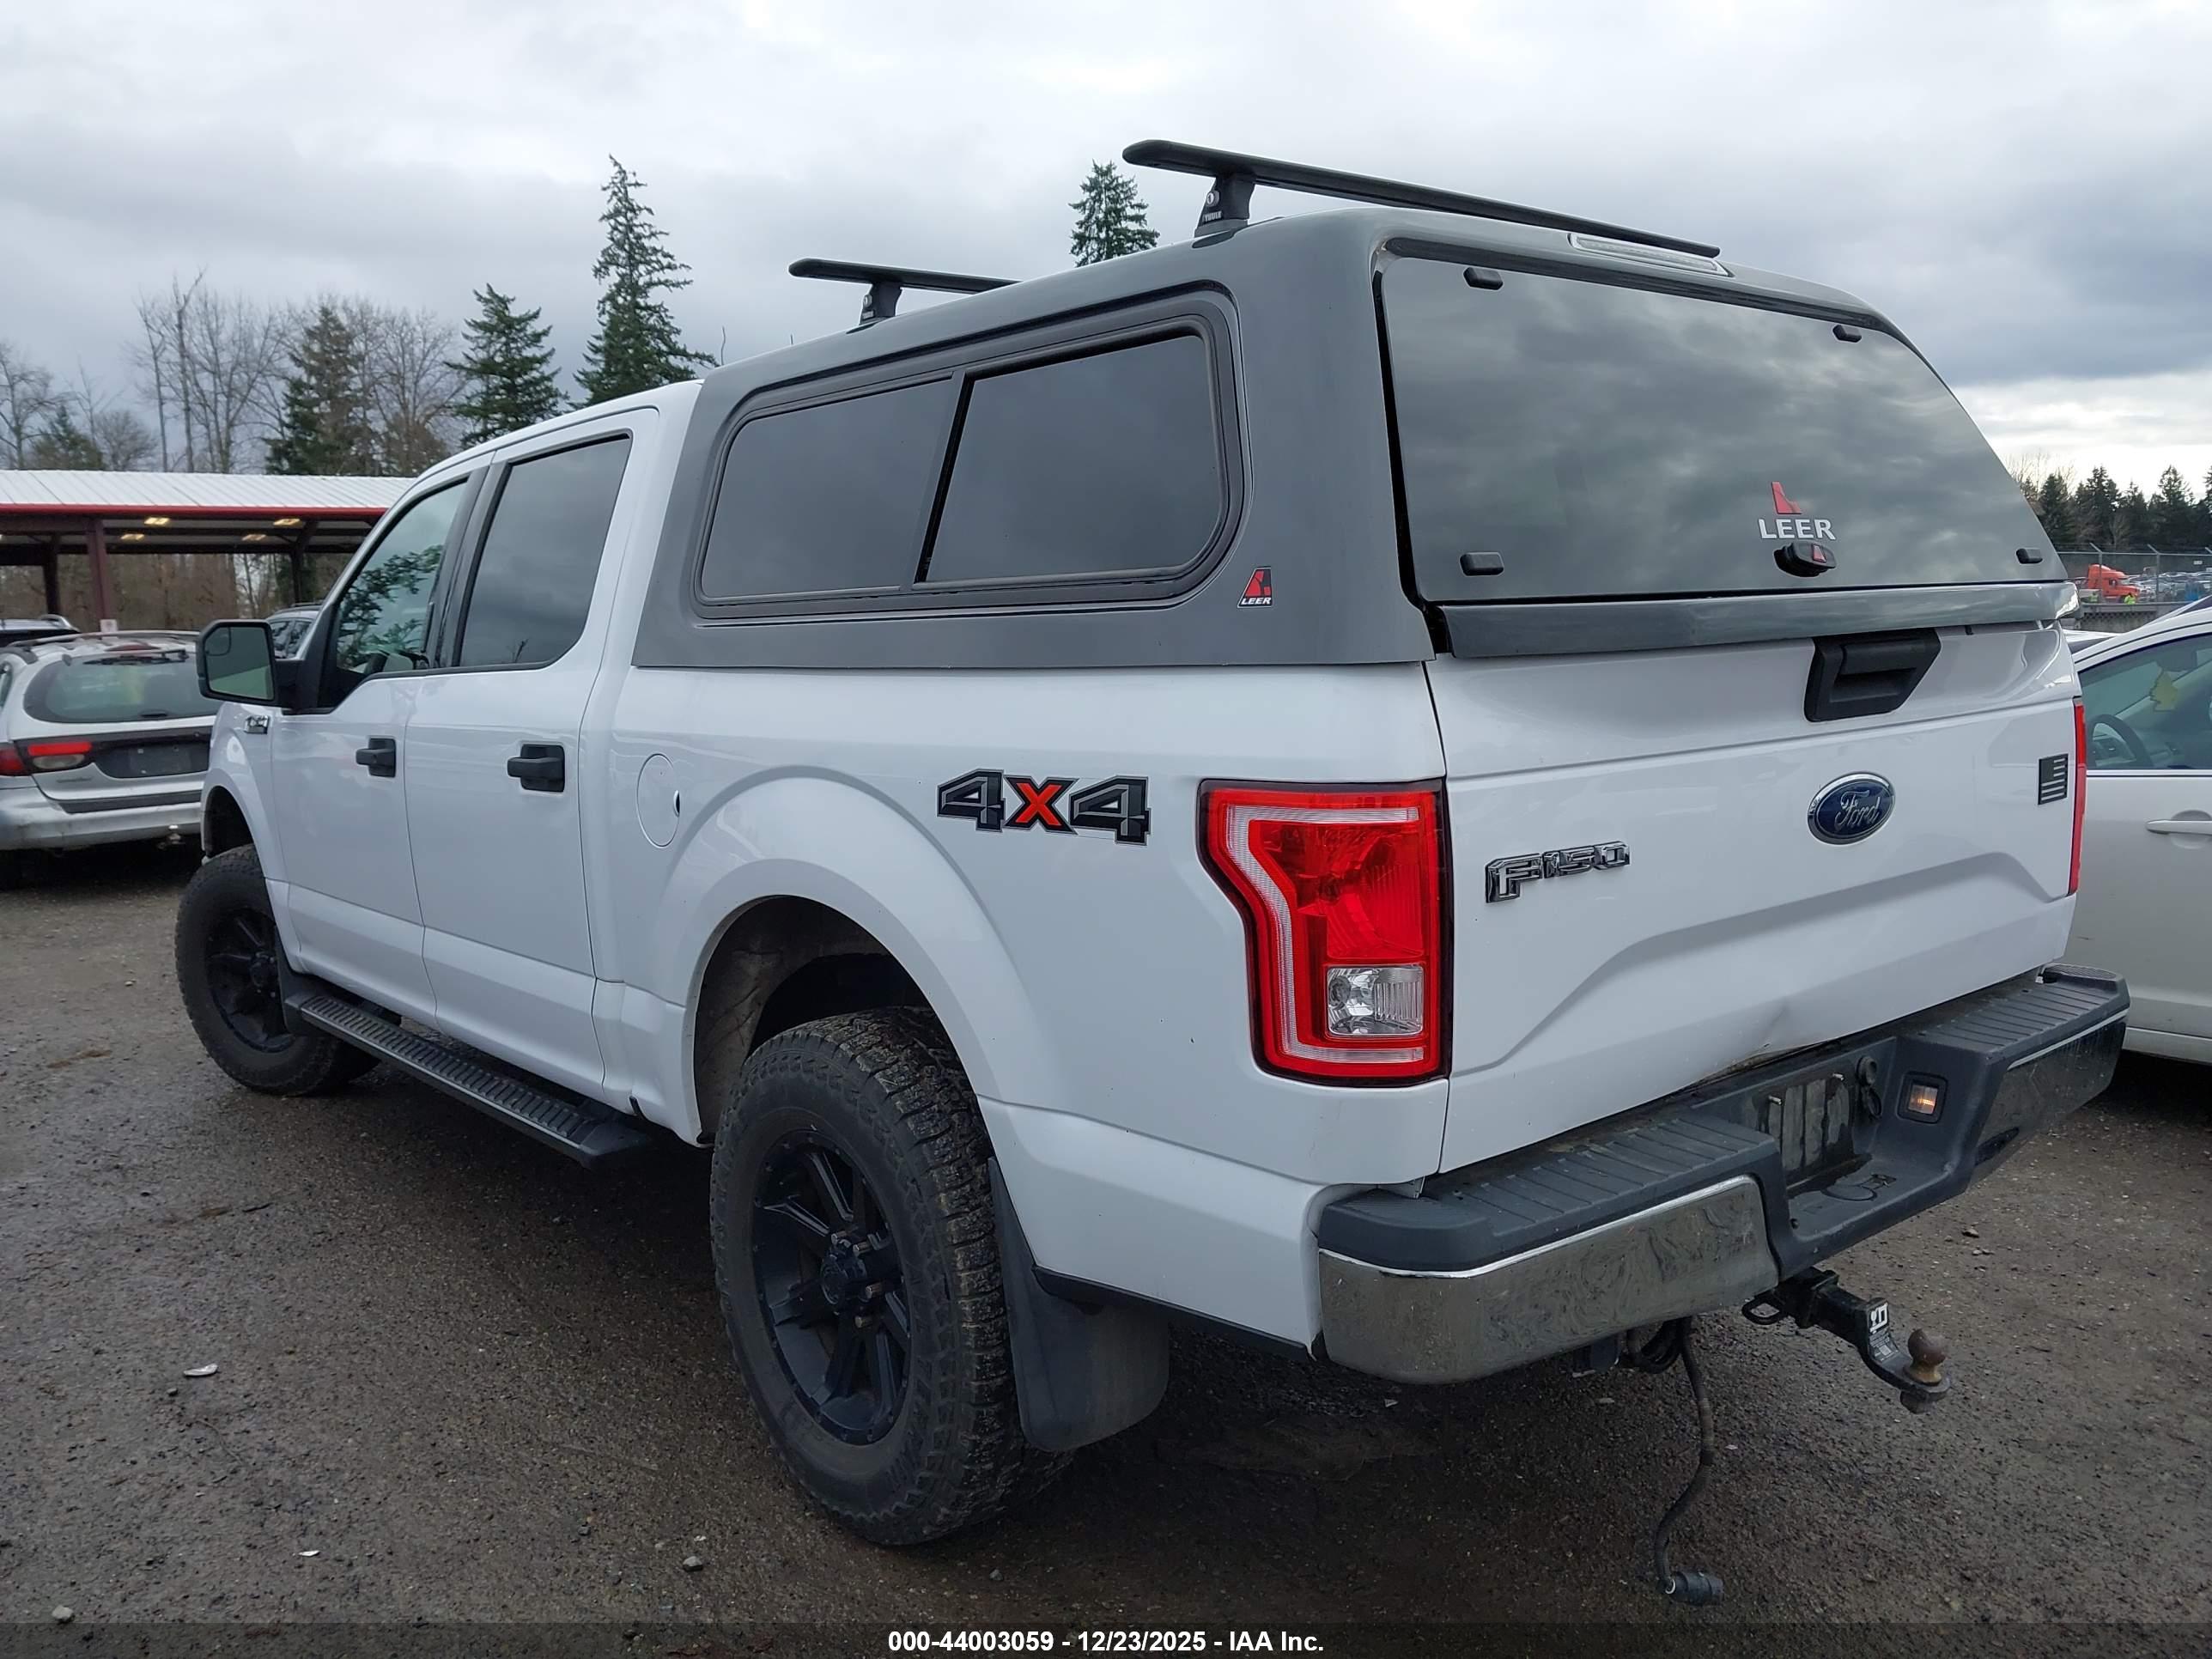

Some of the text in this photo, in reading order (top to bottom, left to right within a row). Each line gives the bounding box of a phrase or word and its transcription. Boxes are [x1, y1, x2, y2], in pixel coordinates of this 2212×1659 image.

[1758, 518, 1836, 540] LEER
[1240, 597, 1272, 605] LEER
[1834, 789, 1882, 831] Ford
